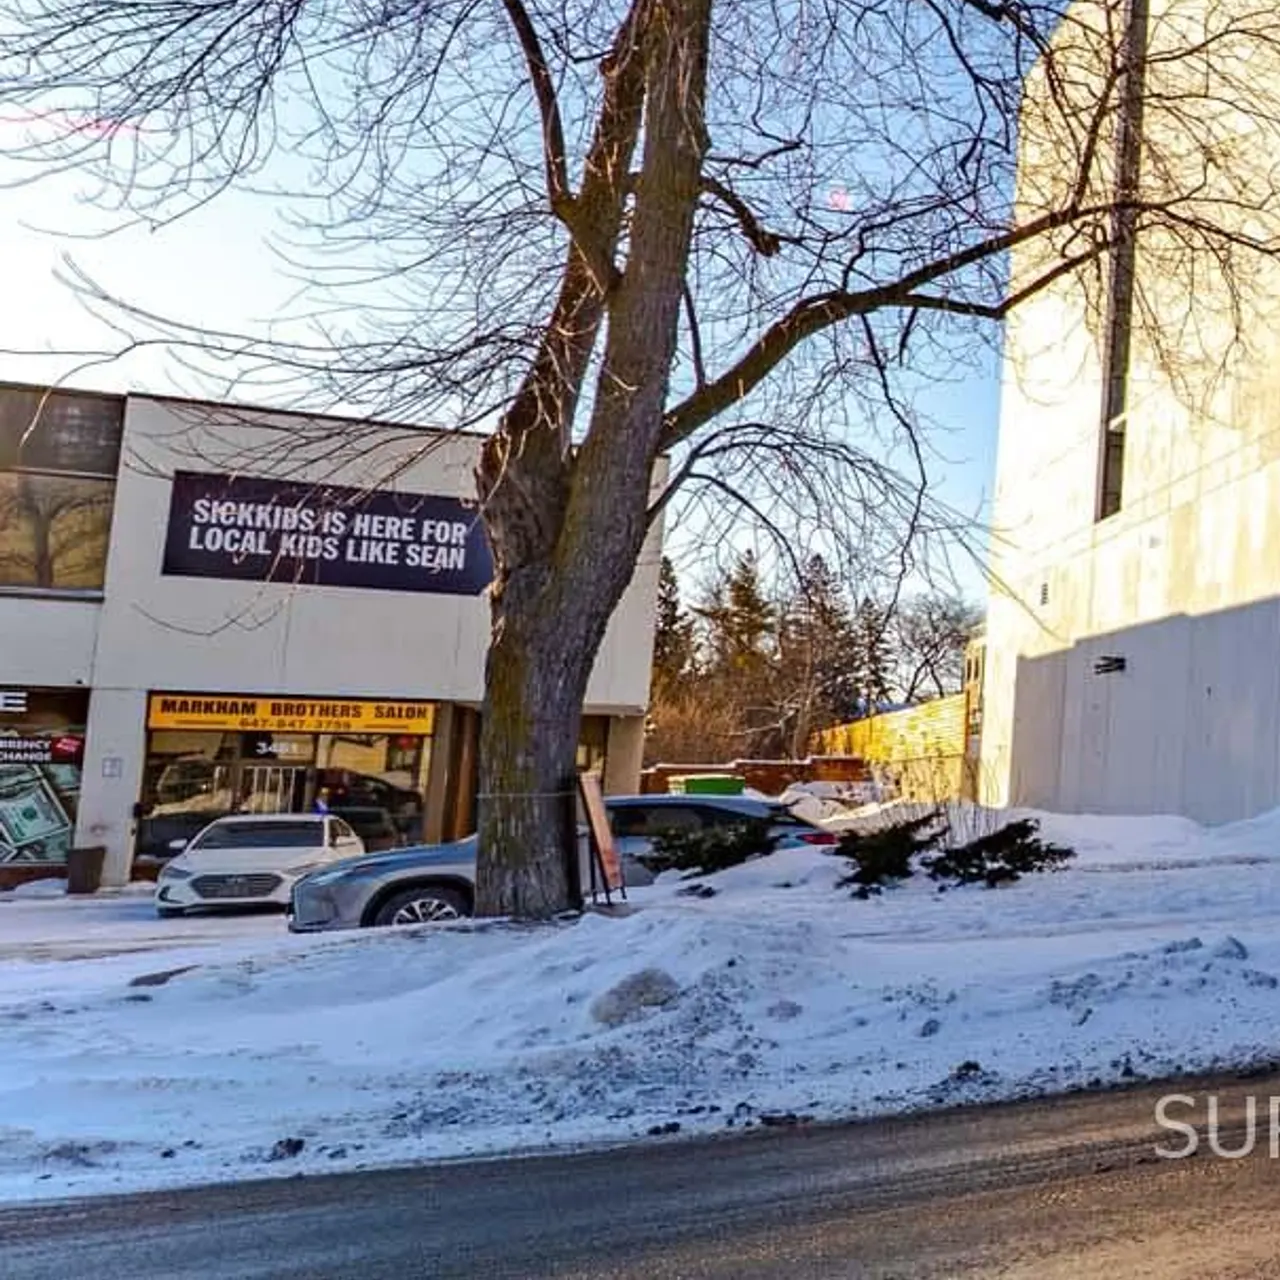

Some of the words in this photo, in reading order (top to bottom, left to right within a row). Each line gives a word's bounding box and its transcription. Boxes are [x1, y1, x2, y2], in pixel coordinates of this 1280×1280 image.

[193, 499, 316, 532] SICKKIDS
[322, 511, 347, 535] IS
[353, 514, 415, 541] HERE
[420, 519, 467, 545] FOR
[189, 526, 272, 556] LOCAL
[279, 532, 341, 561] KIDS
[346, 539, 400, 566] LIKE
[404, 543, 466, 571] SEAN
[160, 699, 257, 715] MARKHAM
[270, 702, 363, 718] BROTHERS
[374, 705, 428, 720] SALON
